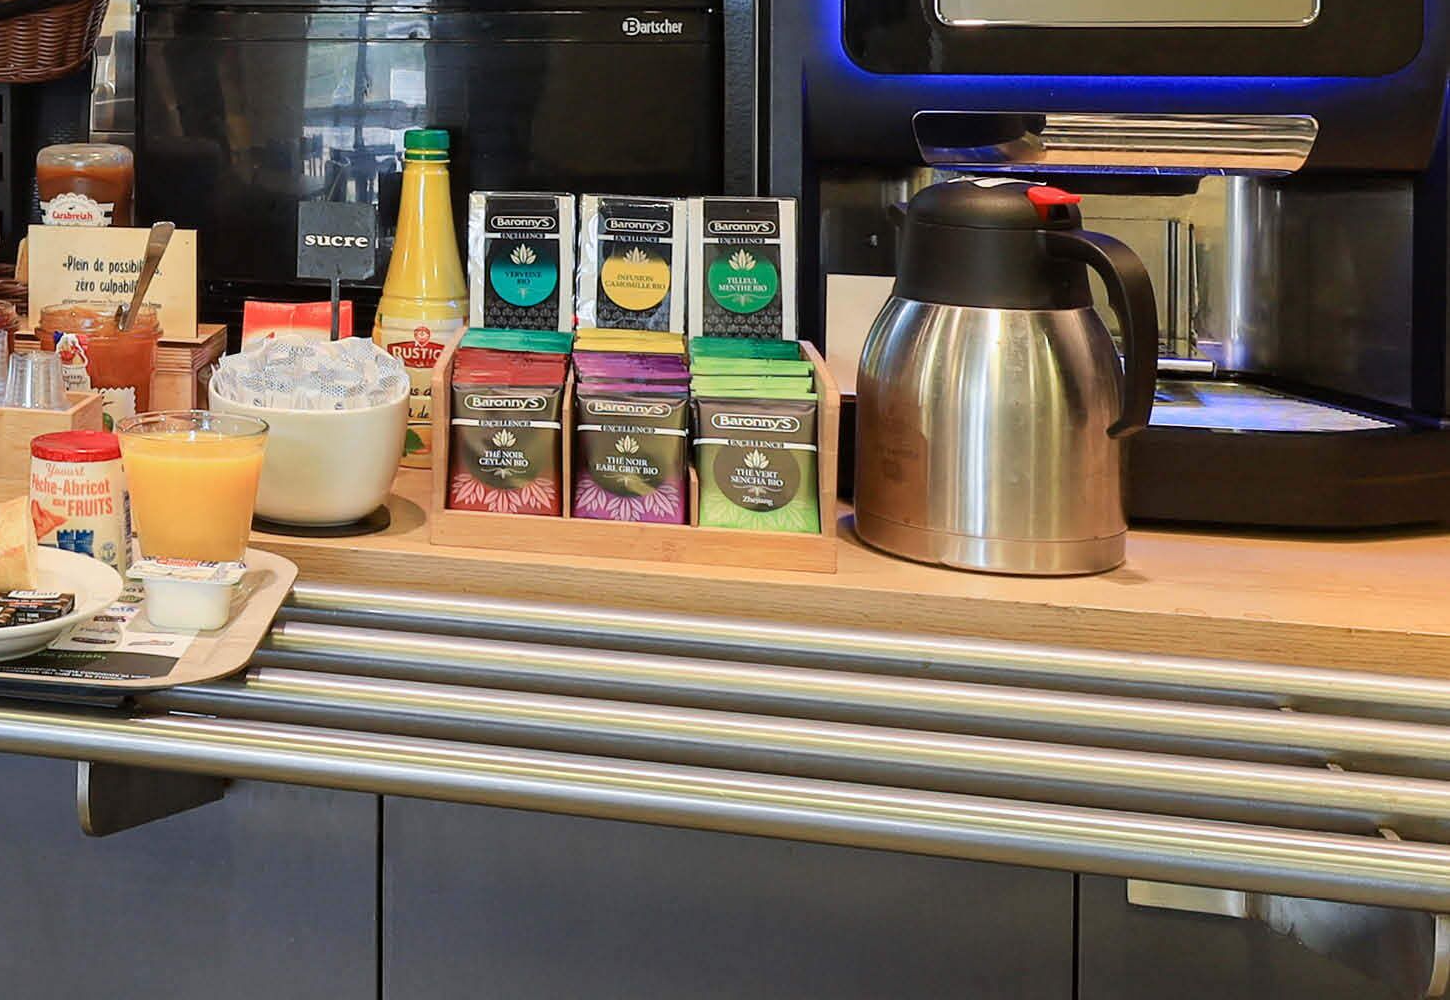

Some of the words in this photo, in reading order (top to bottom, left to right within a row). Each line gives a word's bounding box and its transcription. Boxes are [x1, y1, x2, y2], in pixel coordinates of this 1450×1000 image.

[622, 17, 683, 36] Bartscher
[304, 234, 369, 248] sucre
[615, 234, 659, 243] EXCELLENCE
[94, 258, 104, 271] de
[75, 276, 95, 292] zéro
[718, 283, 752, 292] MENTHE
[753, 284, 767, 292] BIO
[392, 346, 442, 361] RUSTIC
[480, 420, 531, 428] EXCELLENCE
[603, 425, 655, 434] EXCELLENCE
[730, 439, 784, 449] EXCELLENCE
[501, 451, 524, 459] NOIR
[479, 457, 513, 467] CEYLAN
[514, 459, 529, 468] BIO
[626, 458, 648, 467] NOIR
[596, 464, 618, 472] EARL
[619, 465, 643, 474] GREY
[643, 467, 658, 475] BIO
[755, 469, 778, 479] VERT
[730, 475, 767, 485] SENCHA
[768, 478, 784, 487] BIO
[67, 497, 114, 517] FRUITS
